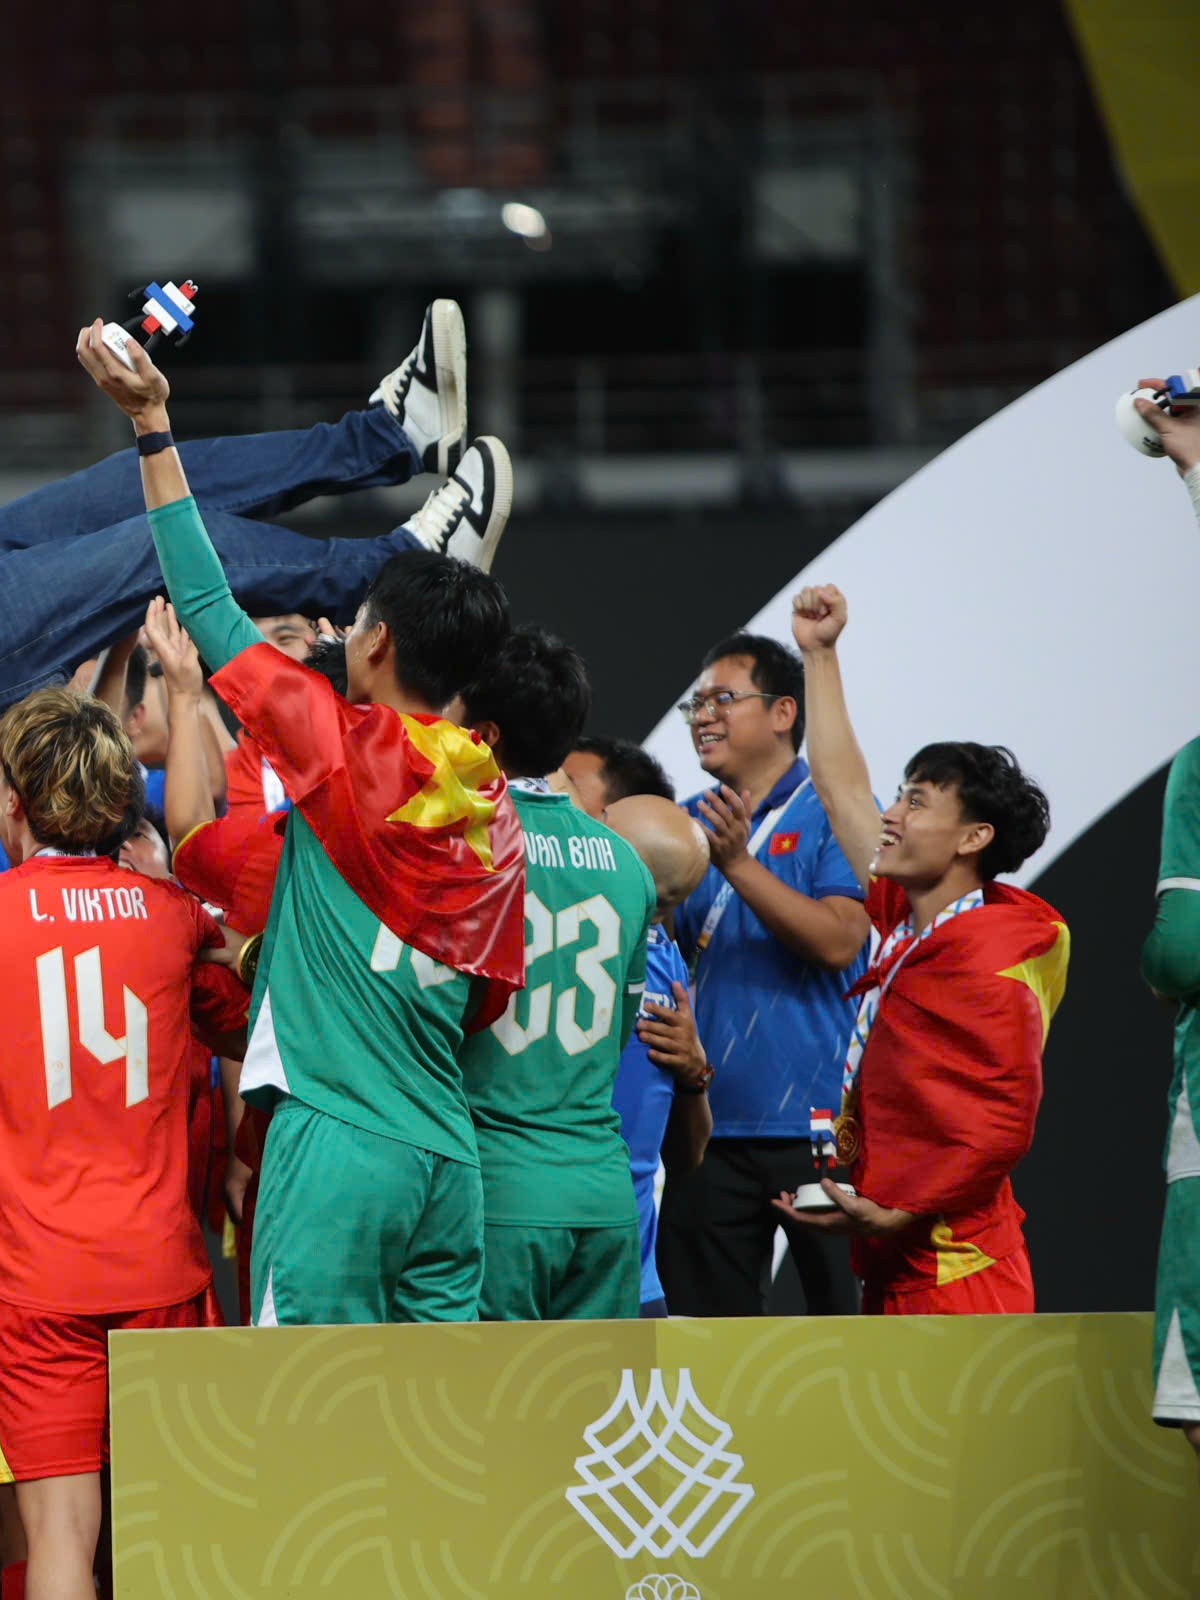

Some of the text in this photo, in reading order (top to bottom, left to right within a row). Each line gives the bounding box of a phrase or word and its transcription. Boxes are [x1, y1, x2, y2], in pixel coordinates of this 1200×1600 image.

[567, 834, 617, 872] BINH
[29, 886, 148, 922] L. VIKTOR
[490, 890, 621, 1056] 23
[35, 945, 149, 1110] 14
